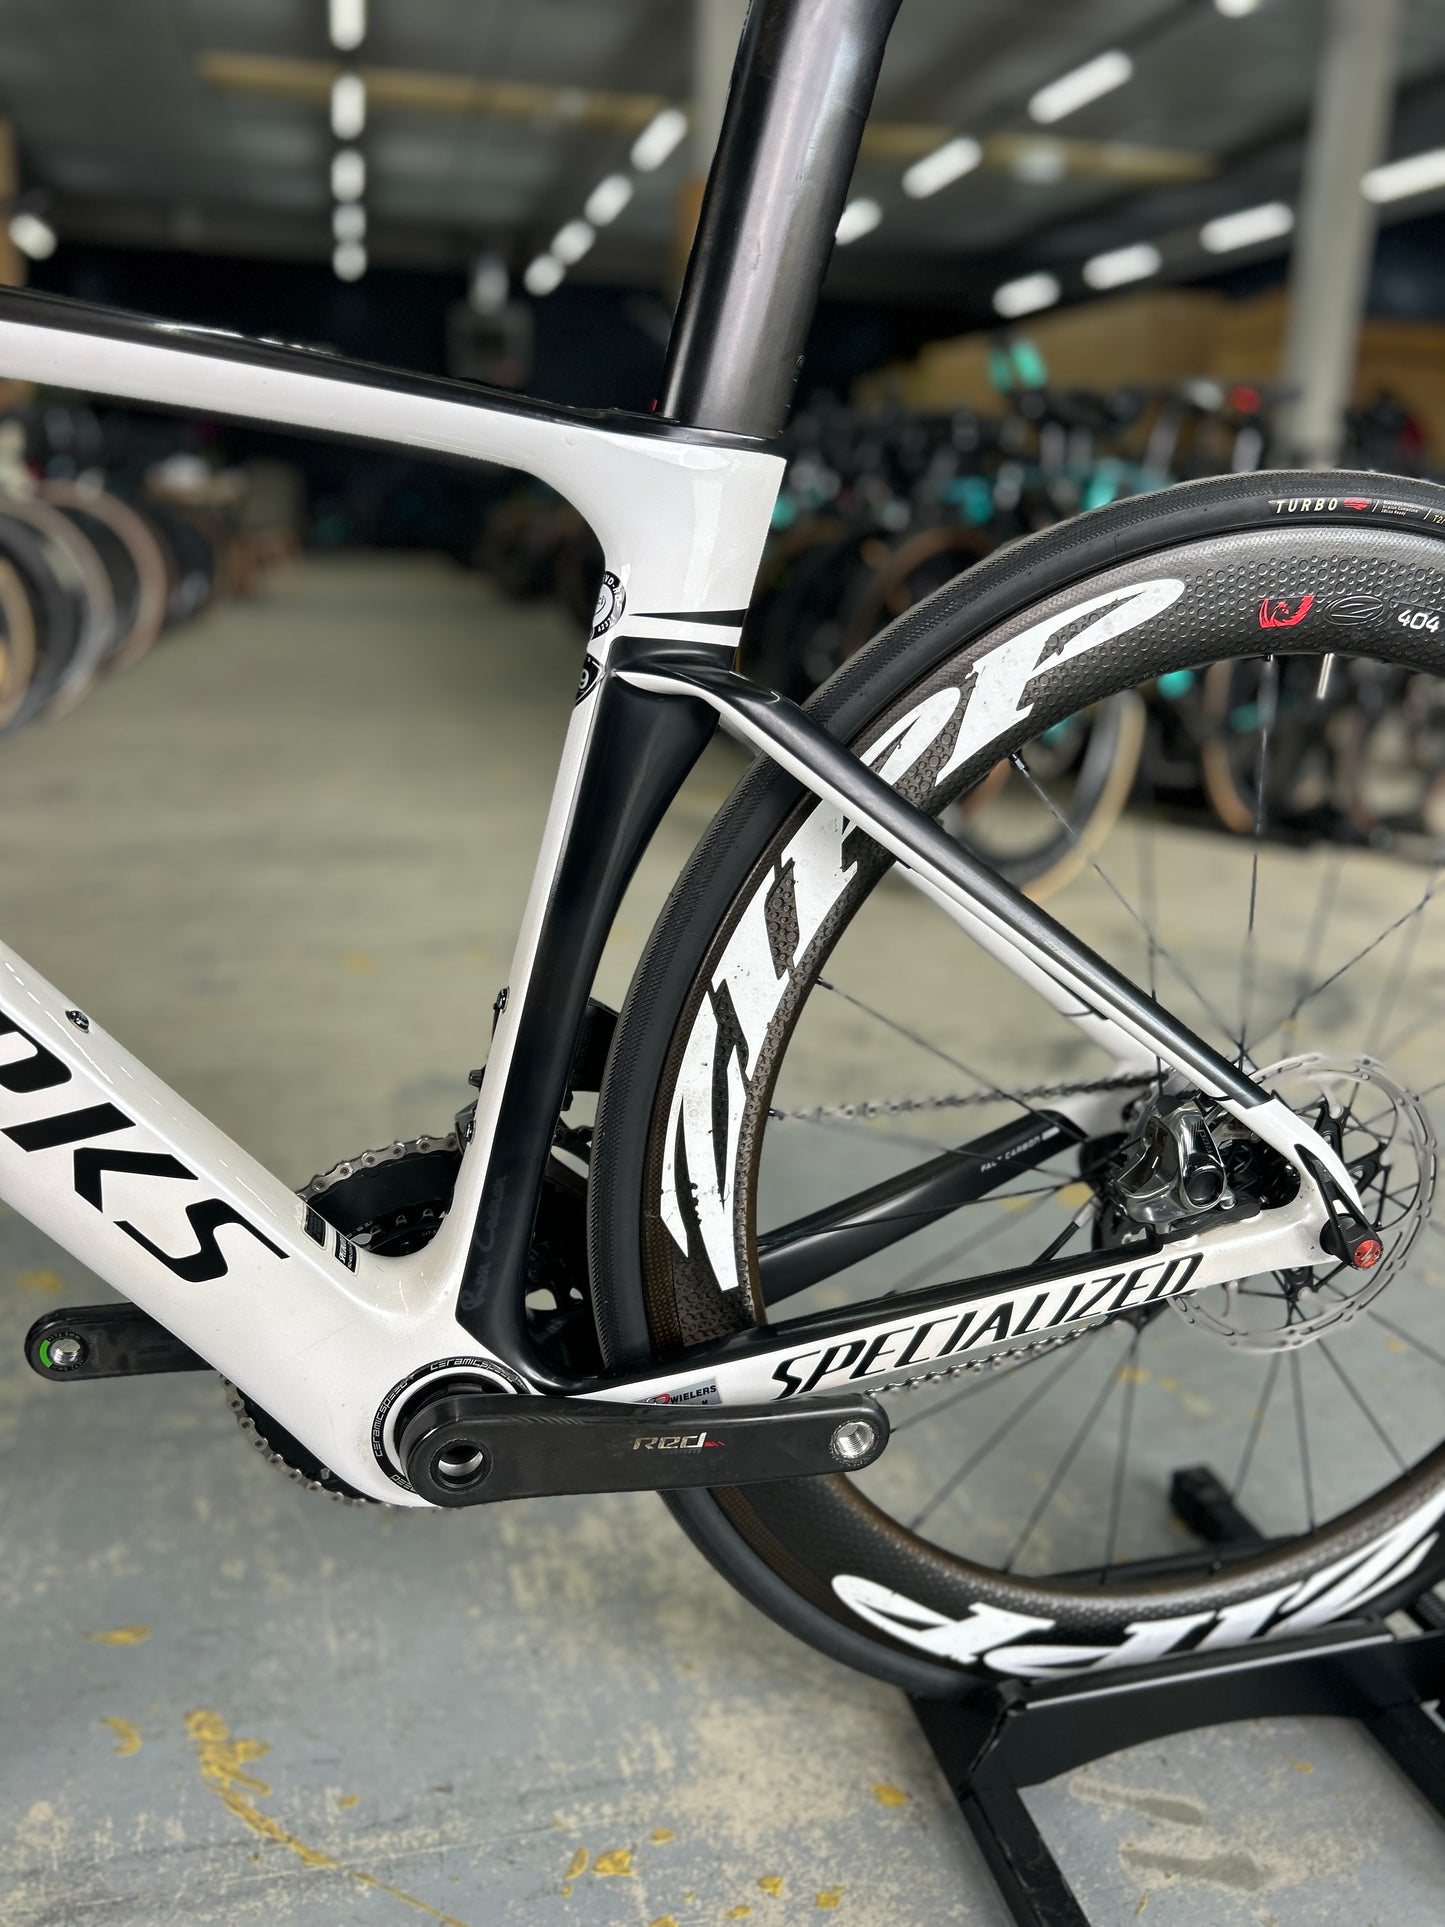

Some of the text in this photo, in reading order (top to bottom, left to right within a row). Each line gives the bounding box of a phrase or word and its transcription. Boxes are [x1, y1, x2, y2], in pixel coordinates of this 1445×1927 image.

[1268, 498, 1338, 513] TURBO
[1397, 609, 1440, 633] 404
[1004, 1135, 1041, 1160] CARBON
[770, 1252, 1204, 1399] SPECIALIZED
[670, 1385, 717, 1405] WIELERS
